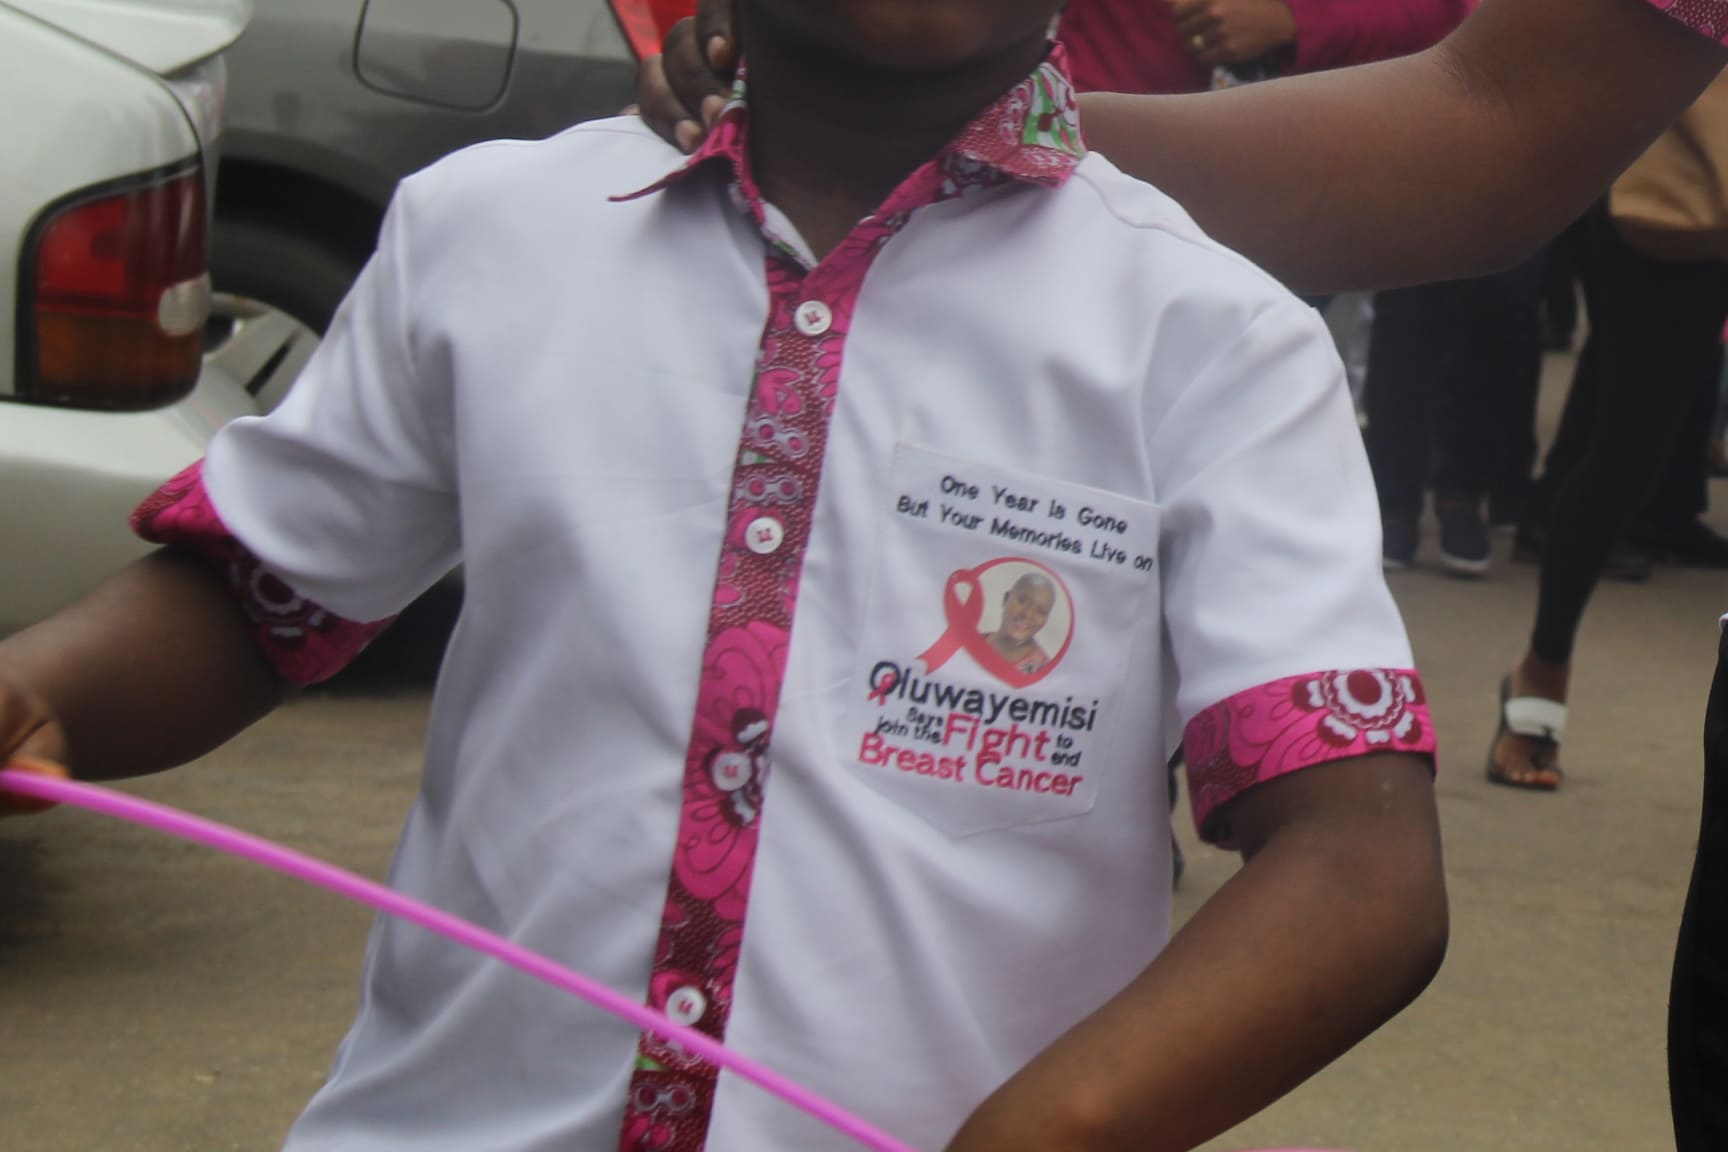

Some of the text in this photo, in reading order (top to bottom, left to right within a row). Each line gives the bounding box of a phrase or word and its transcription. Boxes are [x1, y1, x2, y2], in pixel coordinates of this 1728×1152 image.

[896, 495, 929, 519] But
[939, 504, 985, 530] Your
[989, 517, 1083, 555] Memories
[1090, 540, 1127, 565] Live
[940, 475, 980, 500] One
[992, 485, 1039, 512] Year
[1077, 506, 1129, 535] Gone
[868, 660, 1099, 732] Oluwayemisi
[857, 731, 1084, 797] Breast Cancer
[1050, 750, 1082, 767] end
[1056, 733, 1074, 748] to
